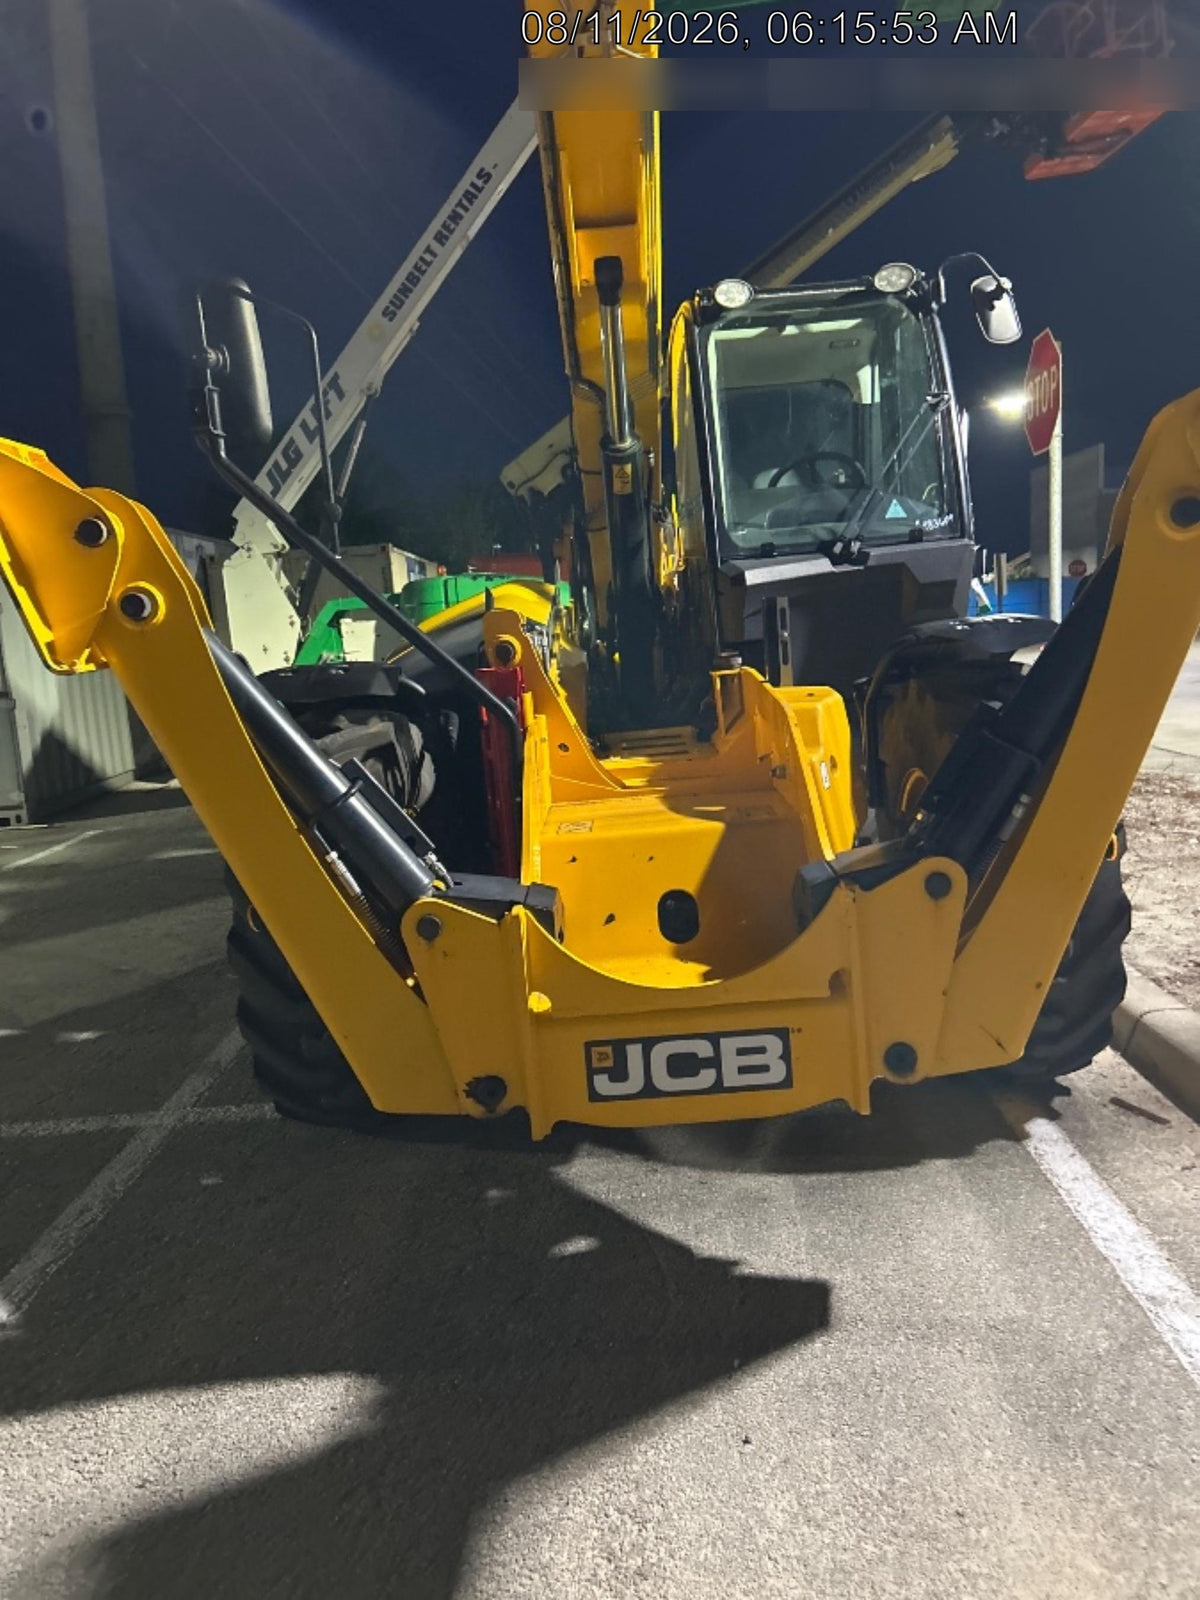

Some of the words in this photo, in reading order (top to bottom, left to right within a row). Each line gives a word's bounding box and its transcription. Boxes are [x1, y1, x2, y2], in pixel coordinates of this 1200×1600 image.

[381, 244, 438, 322] SUNBELT
[433, 167, 493, 247] RENTALS
[1027, 364, 1058, 421] STOP
[266, 436, 304, 498] JLG
[593, 1033, 787, 1096] JCB
